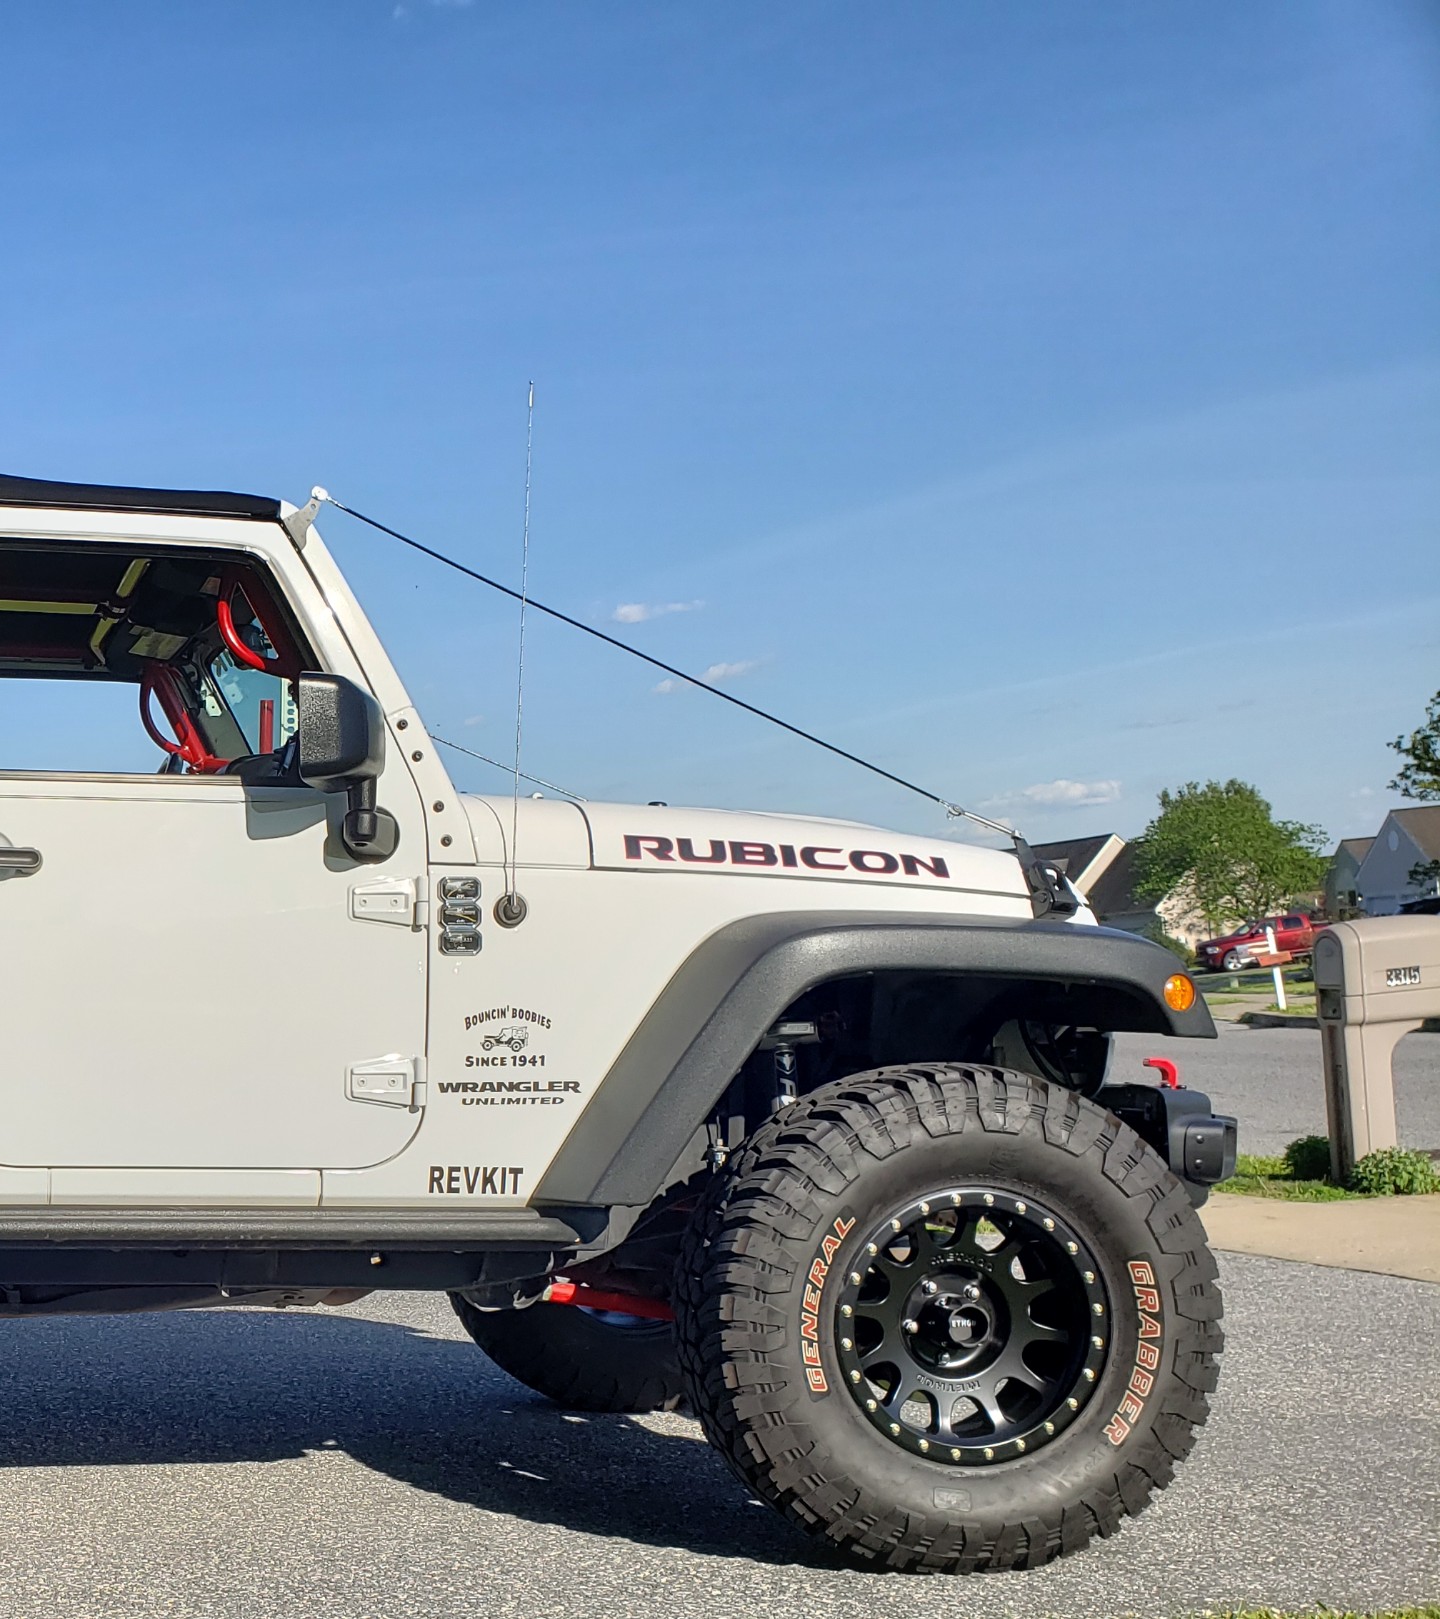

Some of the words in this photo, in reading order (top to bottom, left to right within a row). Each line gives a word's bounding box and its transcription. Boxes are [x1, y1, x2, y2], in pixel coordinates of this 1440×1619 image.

[623, 834, 950, 879] RUBICON
[464, 1005, 510, 1031] BOUNCIN'
[511, 1007, 552, 1030] BOOBIES
[510, 1055, 546, 1067] 1941
[438, 1081, 581, 1093] WRANGLER
[461, 1097, 565, 1106] UNLIMITED
[428, 1166, 524, 1195] REVKIT
[801, 1217, 856, 1392] GENERAL
[1103, 1260, 1161, 1446] GRABBER
